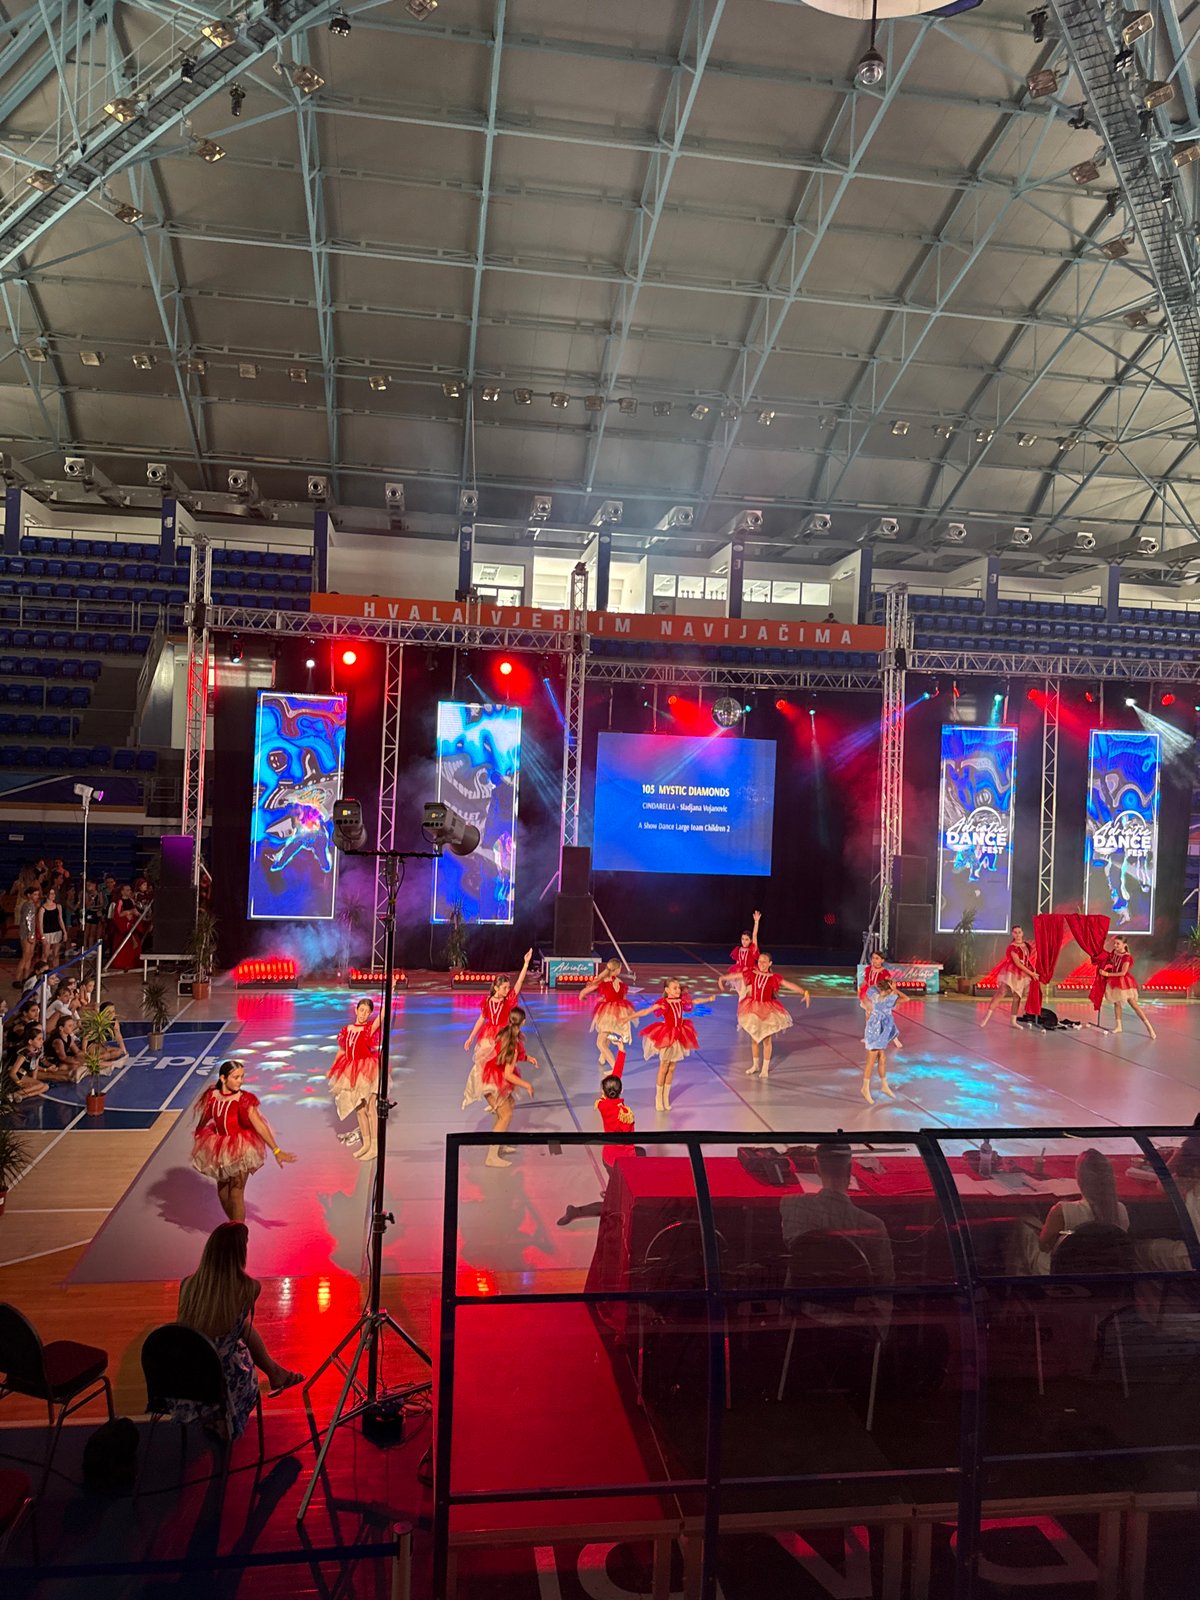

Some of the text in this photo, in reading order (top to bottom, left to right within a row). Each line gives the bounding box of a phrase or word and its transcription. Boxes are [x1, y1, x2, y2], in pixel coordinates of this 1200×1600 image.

[364, 602, 463, 623] HVALA
[660, 620, 852, 644] NAVIJAČIMA
[642, 784, 655, 794] 105
[659, 785, 687, 796] MYSTIC
[688, 786, 730, 798] DIAMONDS
[642, 802, 676, 811] CINDARELLA
[644, 822, 657, 830] Show
[675, 823, 690, 832] Large
[704, 824, 726, 832] Children
[946, 816, 1008, 834] Adriatic
[1092, 820, 1152, 837] Adriatic
[946, 831, 1007, 846] DANCE
[1093, 835, 1152, 849] DANCE
[982, 846, 1004, 854] FEST
[1127, 849, 1149, 857] FEST
